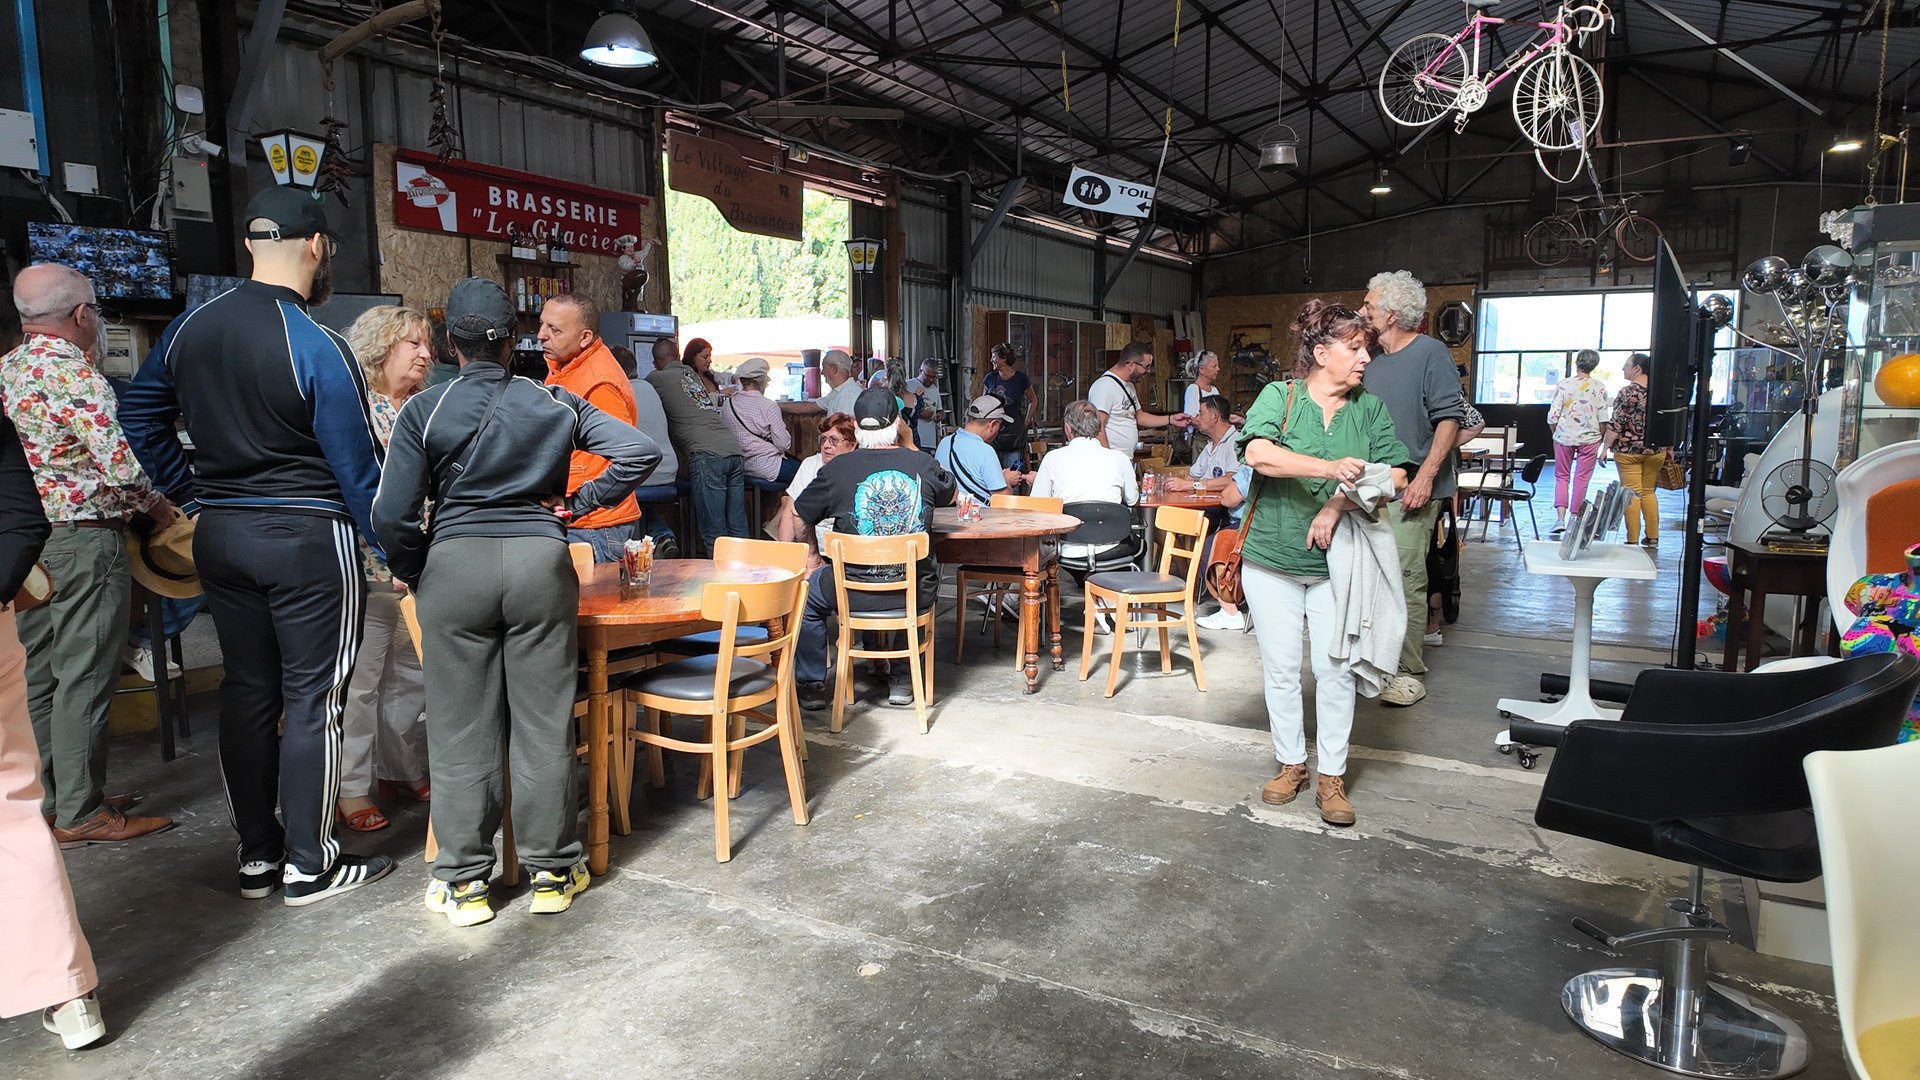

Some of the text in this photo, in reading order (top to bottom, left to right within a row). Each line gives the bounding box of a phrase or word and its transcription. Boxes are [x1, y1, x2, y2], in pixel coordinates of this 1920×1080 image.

[673, 143, 746, 182] Le Village
[714, 180, 731, 198] du
[1118, 185, 1153, 200] TOIL
[488, 185, 619, 228] BRASSERIE
